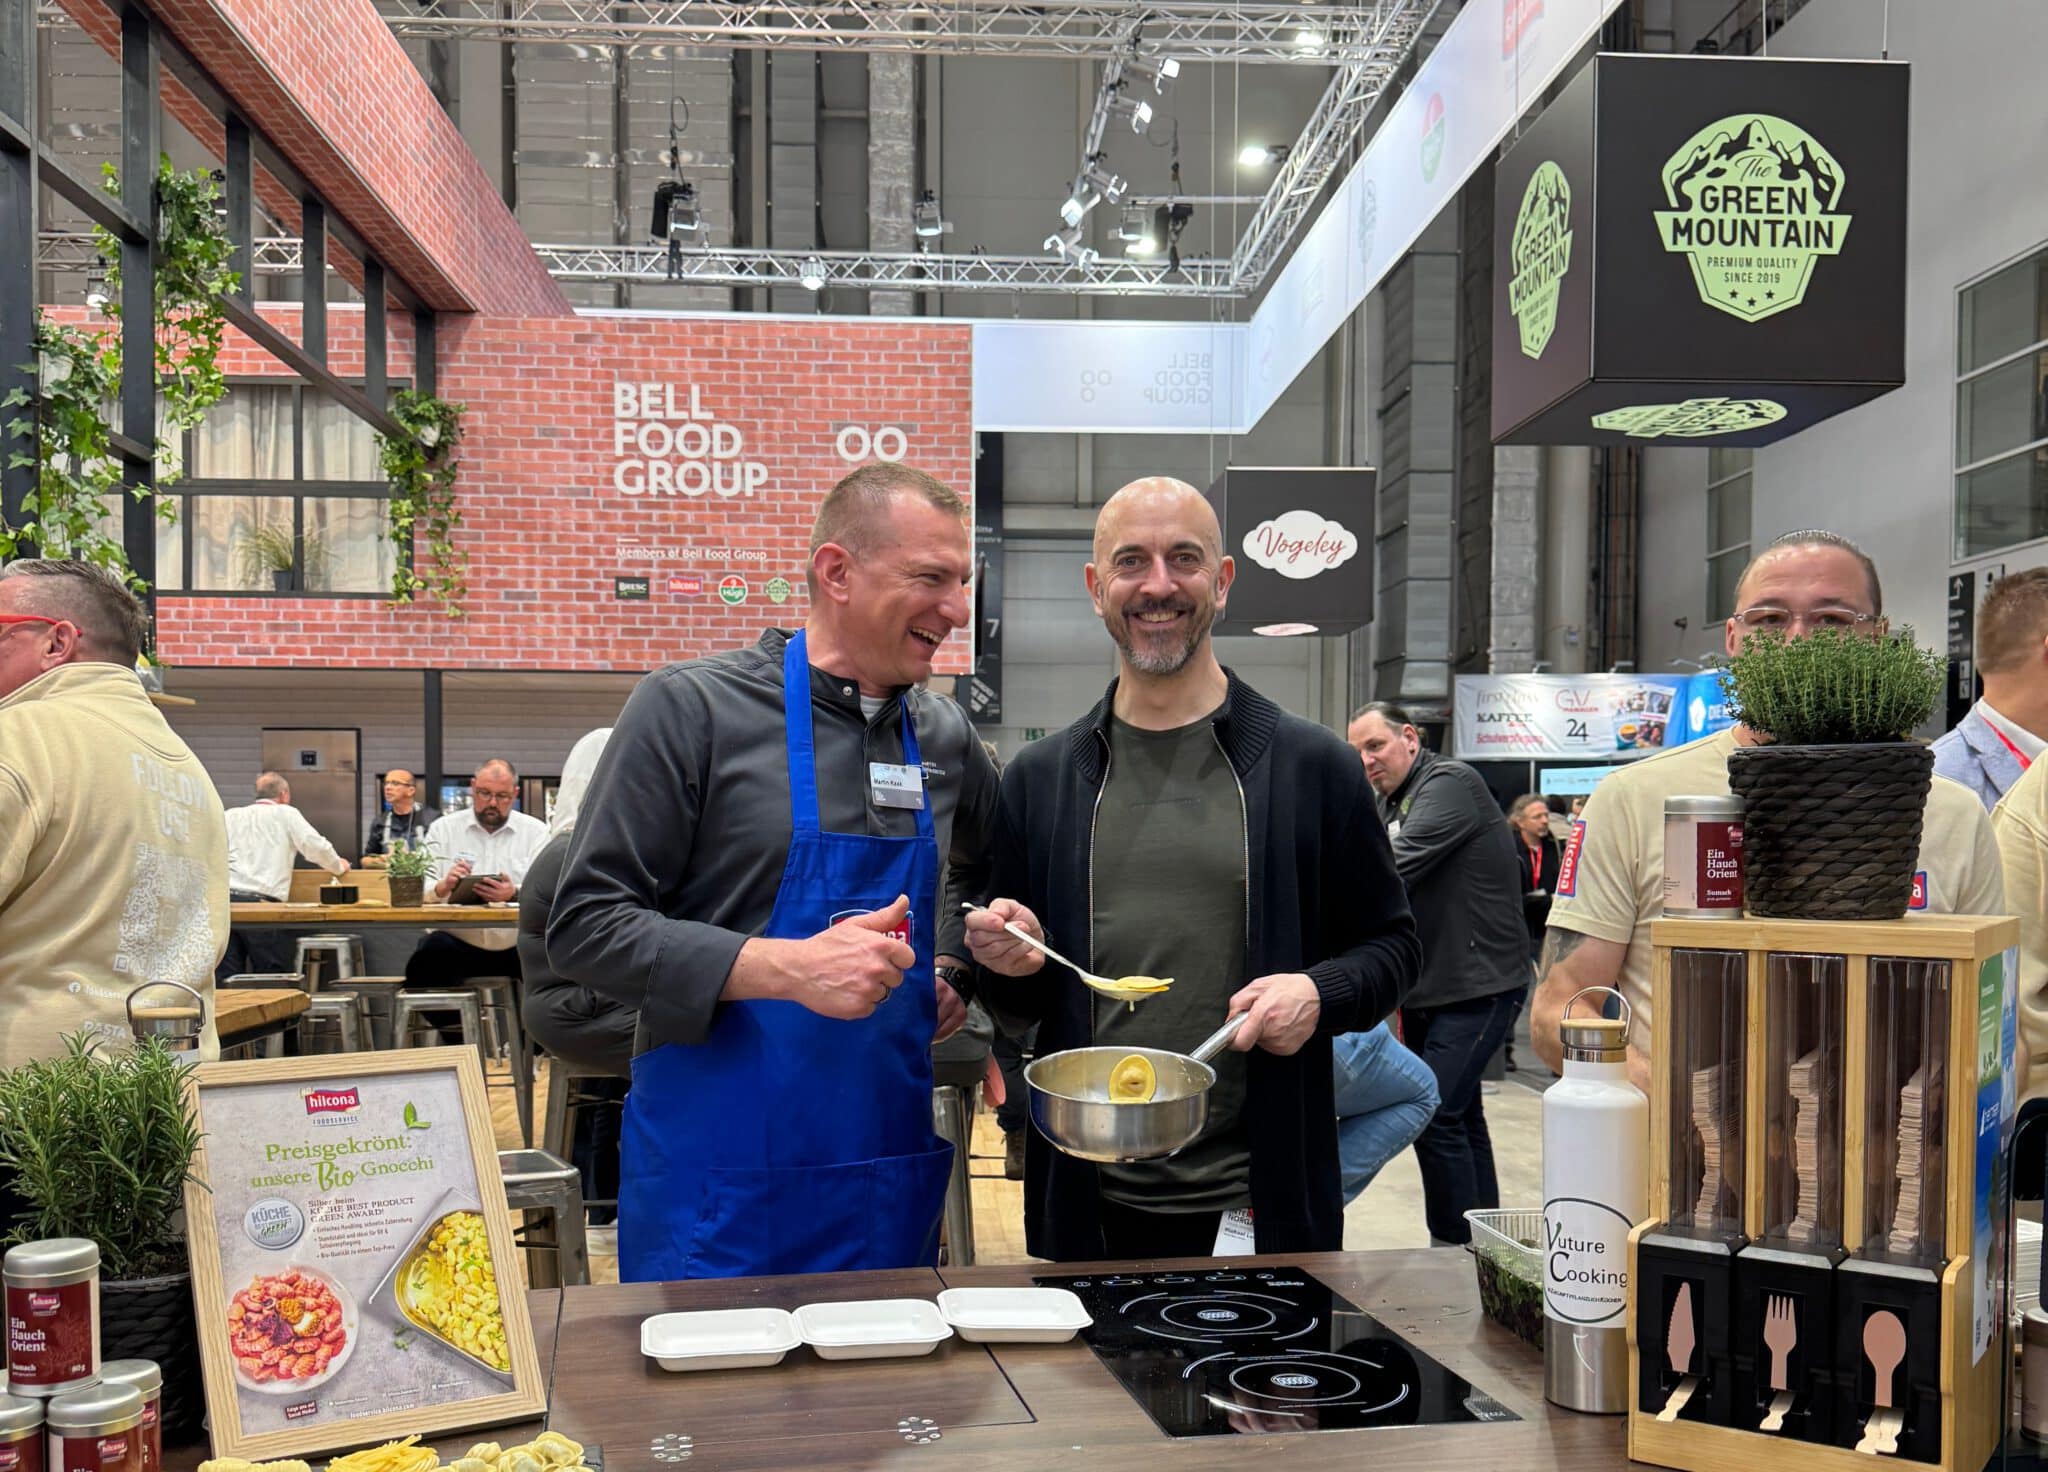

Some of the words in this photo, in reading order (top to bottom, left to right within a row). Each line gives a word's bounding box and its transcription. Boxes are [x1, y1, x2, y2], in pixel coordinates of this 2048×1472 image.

[1735, 154, 1772, 183] The
[1700, 184, 1807, 215] GREEN
[1523, 218, 1558, 269] GREEN
[1671, 218, 1834, 249] MOUNTAIN
[1707, 255, 1753, 268] PREMIUM
[1756, 256, 1798, 270] QUALITY
[1514, 238, 1567, 309] MOUNTAIN
[1724, 272, 1753, 284] SINCE
[1757, 272, 1781, 284] 2019
[614, 382, 714, 419] BELL
[614, 422, 743, 459] FOOD
[613, 460, 769, 497] GROUP
[616, 548, 665, 560] Members
[668, 548, 680, 560] of
[682, 549, 702, 560] Bell
[705, 549, 731, 560] Food
[734, 550, 768, 563] Group
[1257, 526, 1347, 564] Vogeley
[986, 618, 1000, 638] 7
[1555, 689, 1591, 709] GV
[1566, 718, 1590, 741] 24
[1560, 826, 1582, 889] hilcona
[1707, 849, 1725, 859] Ein
[1707, 858, 1738, 869] Hauch
[1707, 869, 1738, 879] Orient
[309, 1094, 355, 1108] hilcona
[265, 1136, 413, 1162] Preisgekrönt:
[251, 1172, 313, 1188] unsere
[311, 1160, 358, 1192] Bio
[361, 1155, 434, 1176] Gnocchi
[346, 1202, 369, 1211] BEST
[371, 1197, 415, 1208] PRODUCT
[251, 1206, 291, 1224] KÜCHE
[1550, 1251, 1628, 1288] Cooking
[11, 1317, 26, 1329] Ein
[11, 1329, 46, 1340] Hauch
[11, 1340, 46, 1351] Orient
